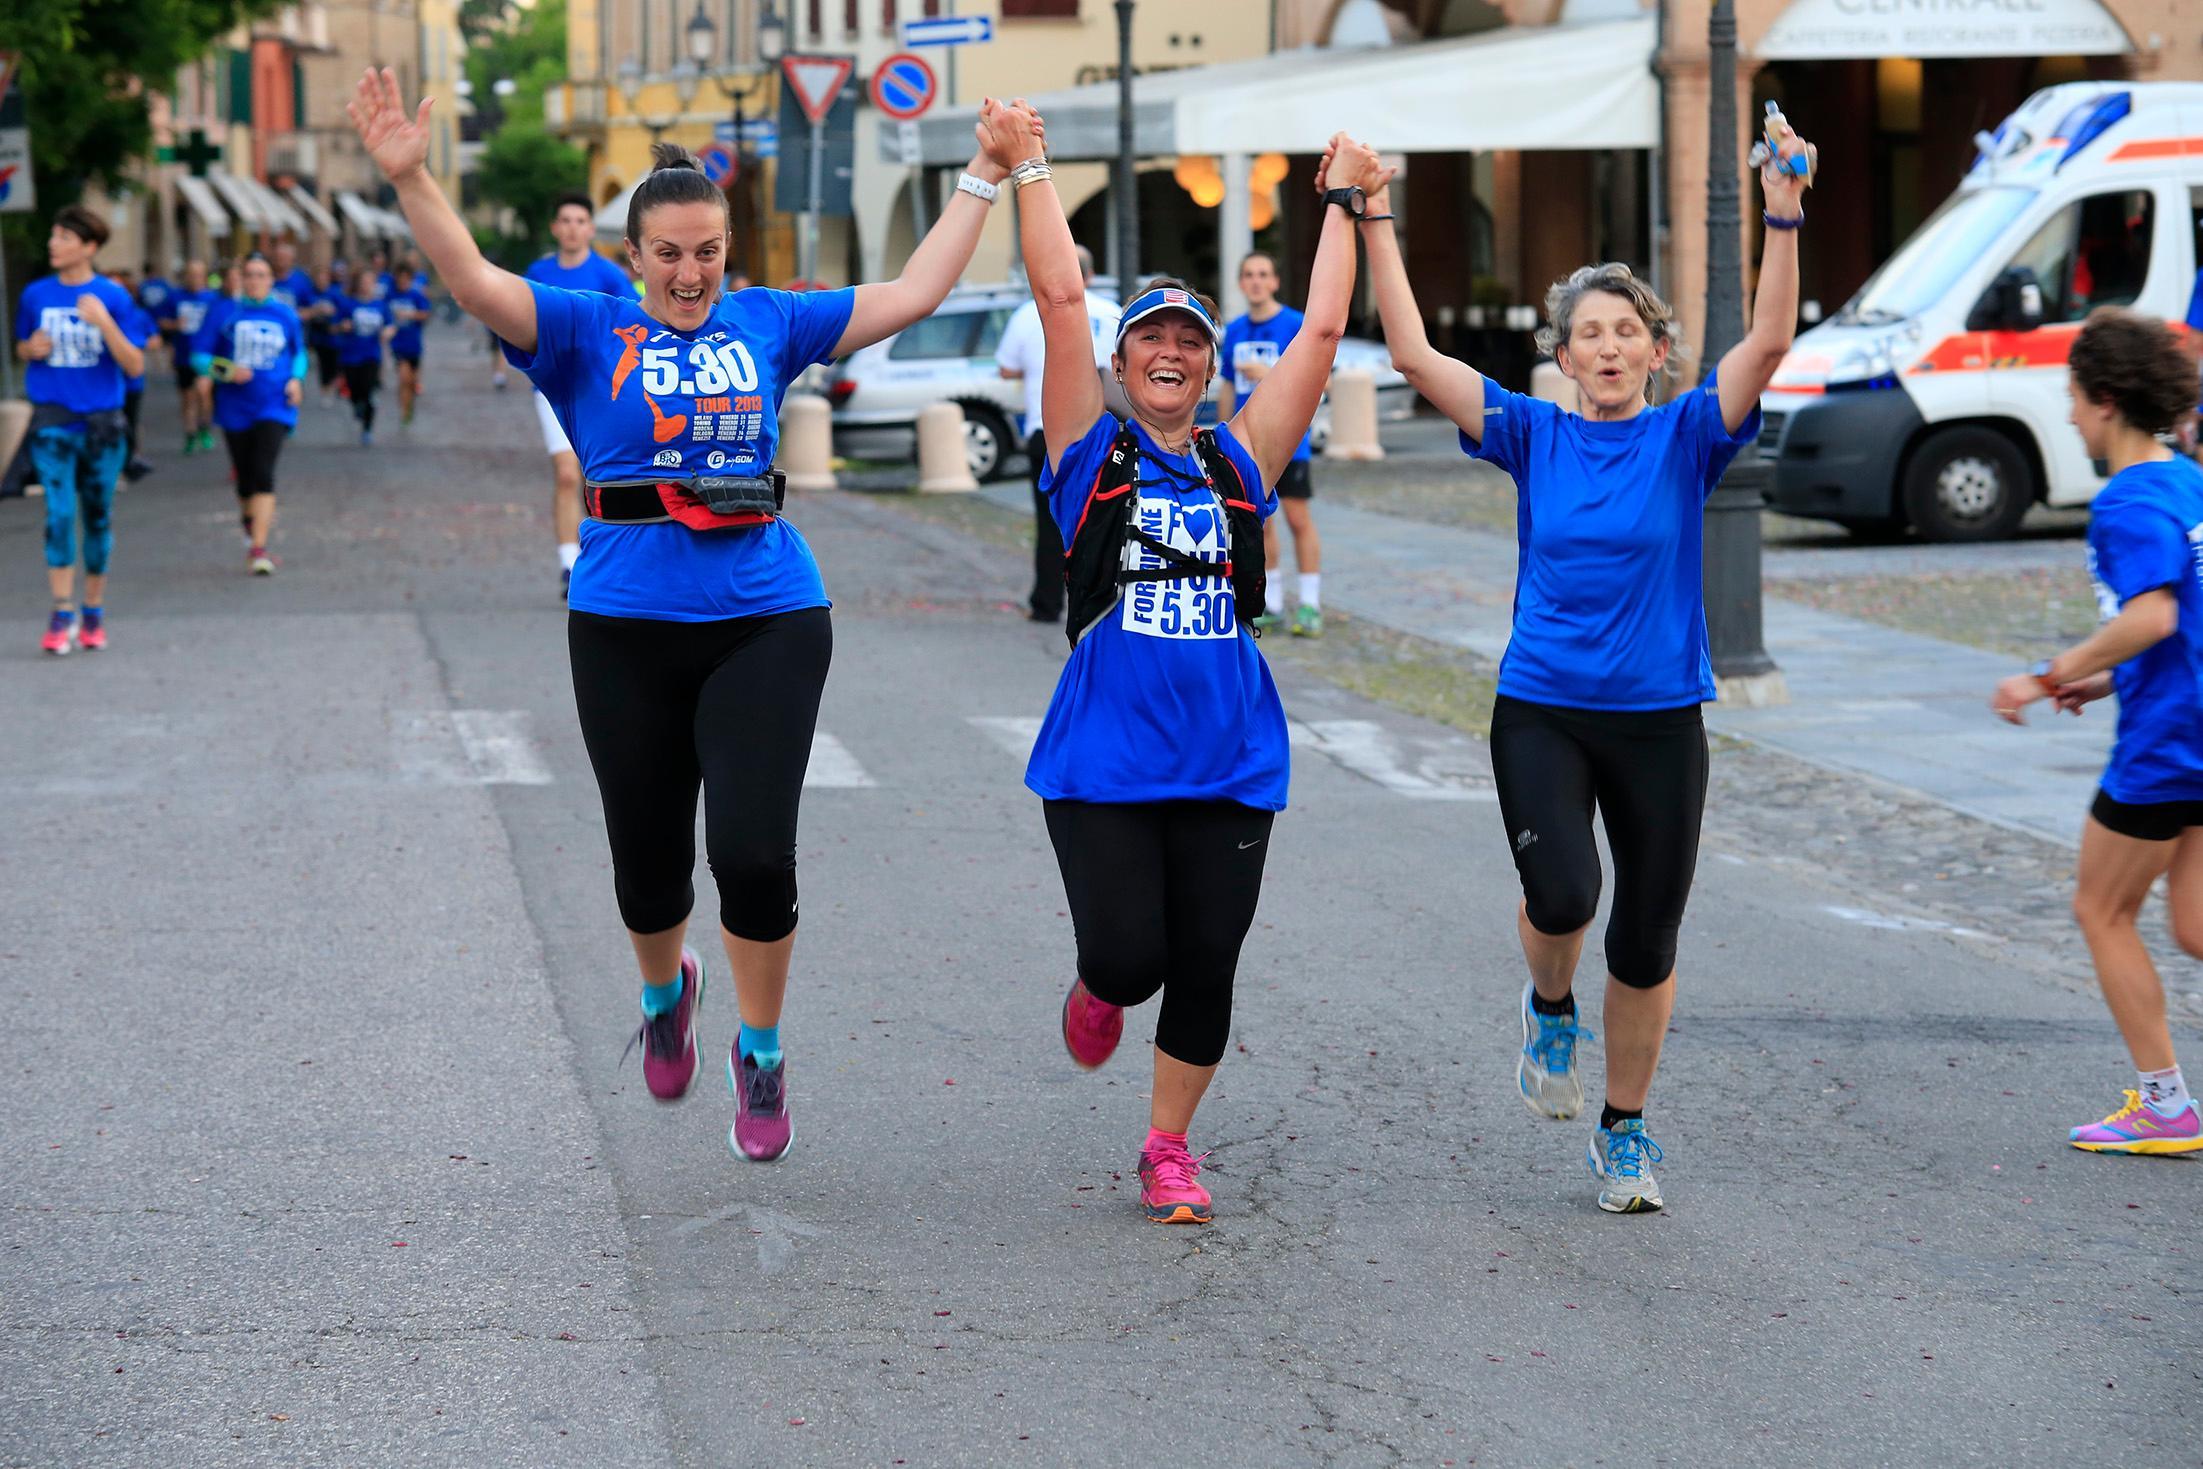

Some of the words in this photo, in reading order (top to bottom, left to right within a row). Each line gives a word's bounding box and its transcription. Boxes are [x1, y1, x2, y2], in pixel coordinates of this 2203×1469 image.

[642, 340, 759, 396] 5.30
[694, 397, 731, 413] TOUR
[1160, 591, 1235, 636] 5.30
